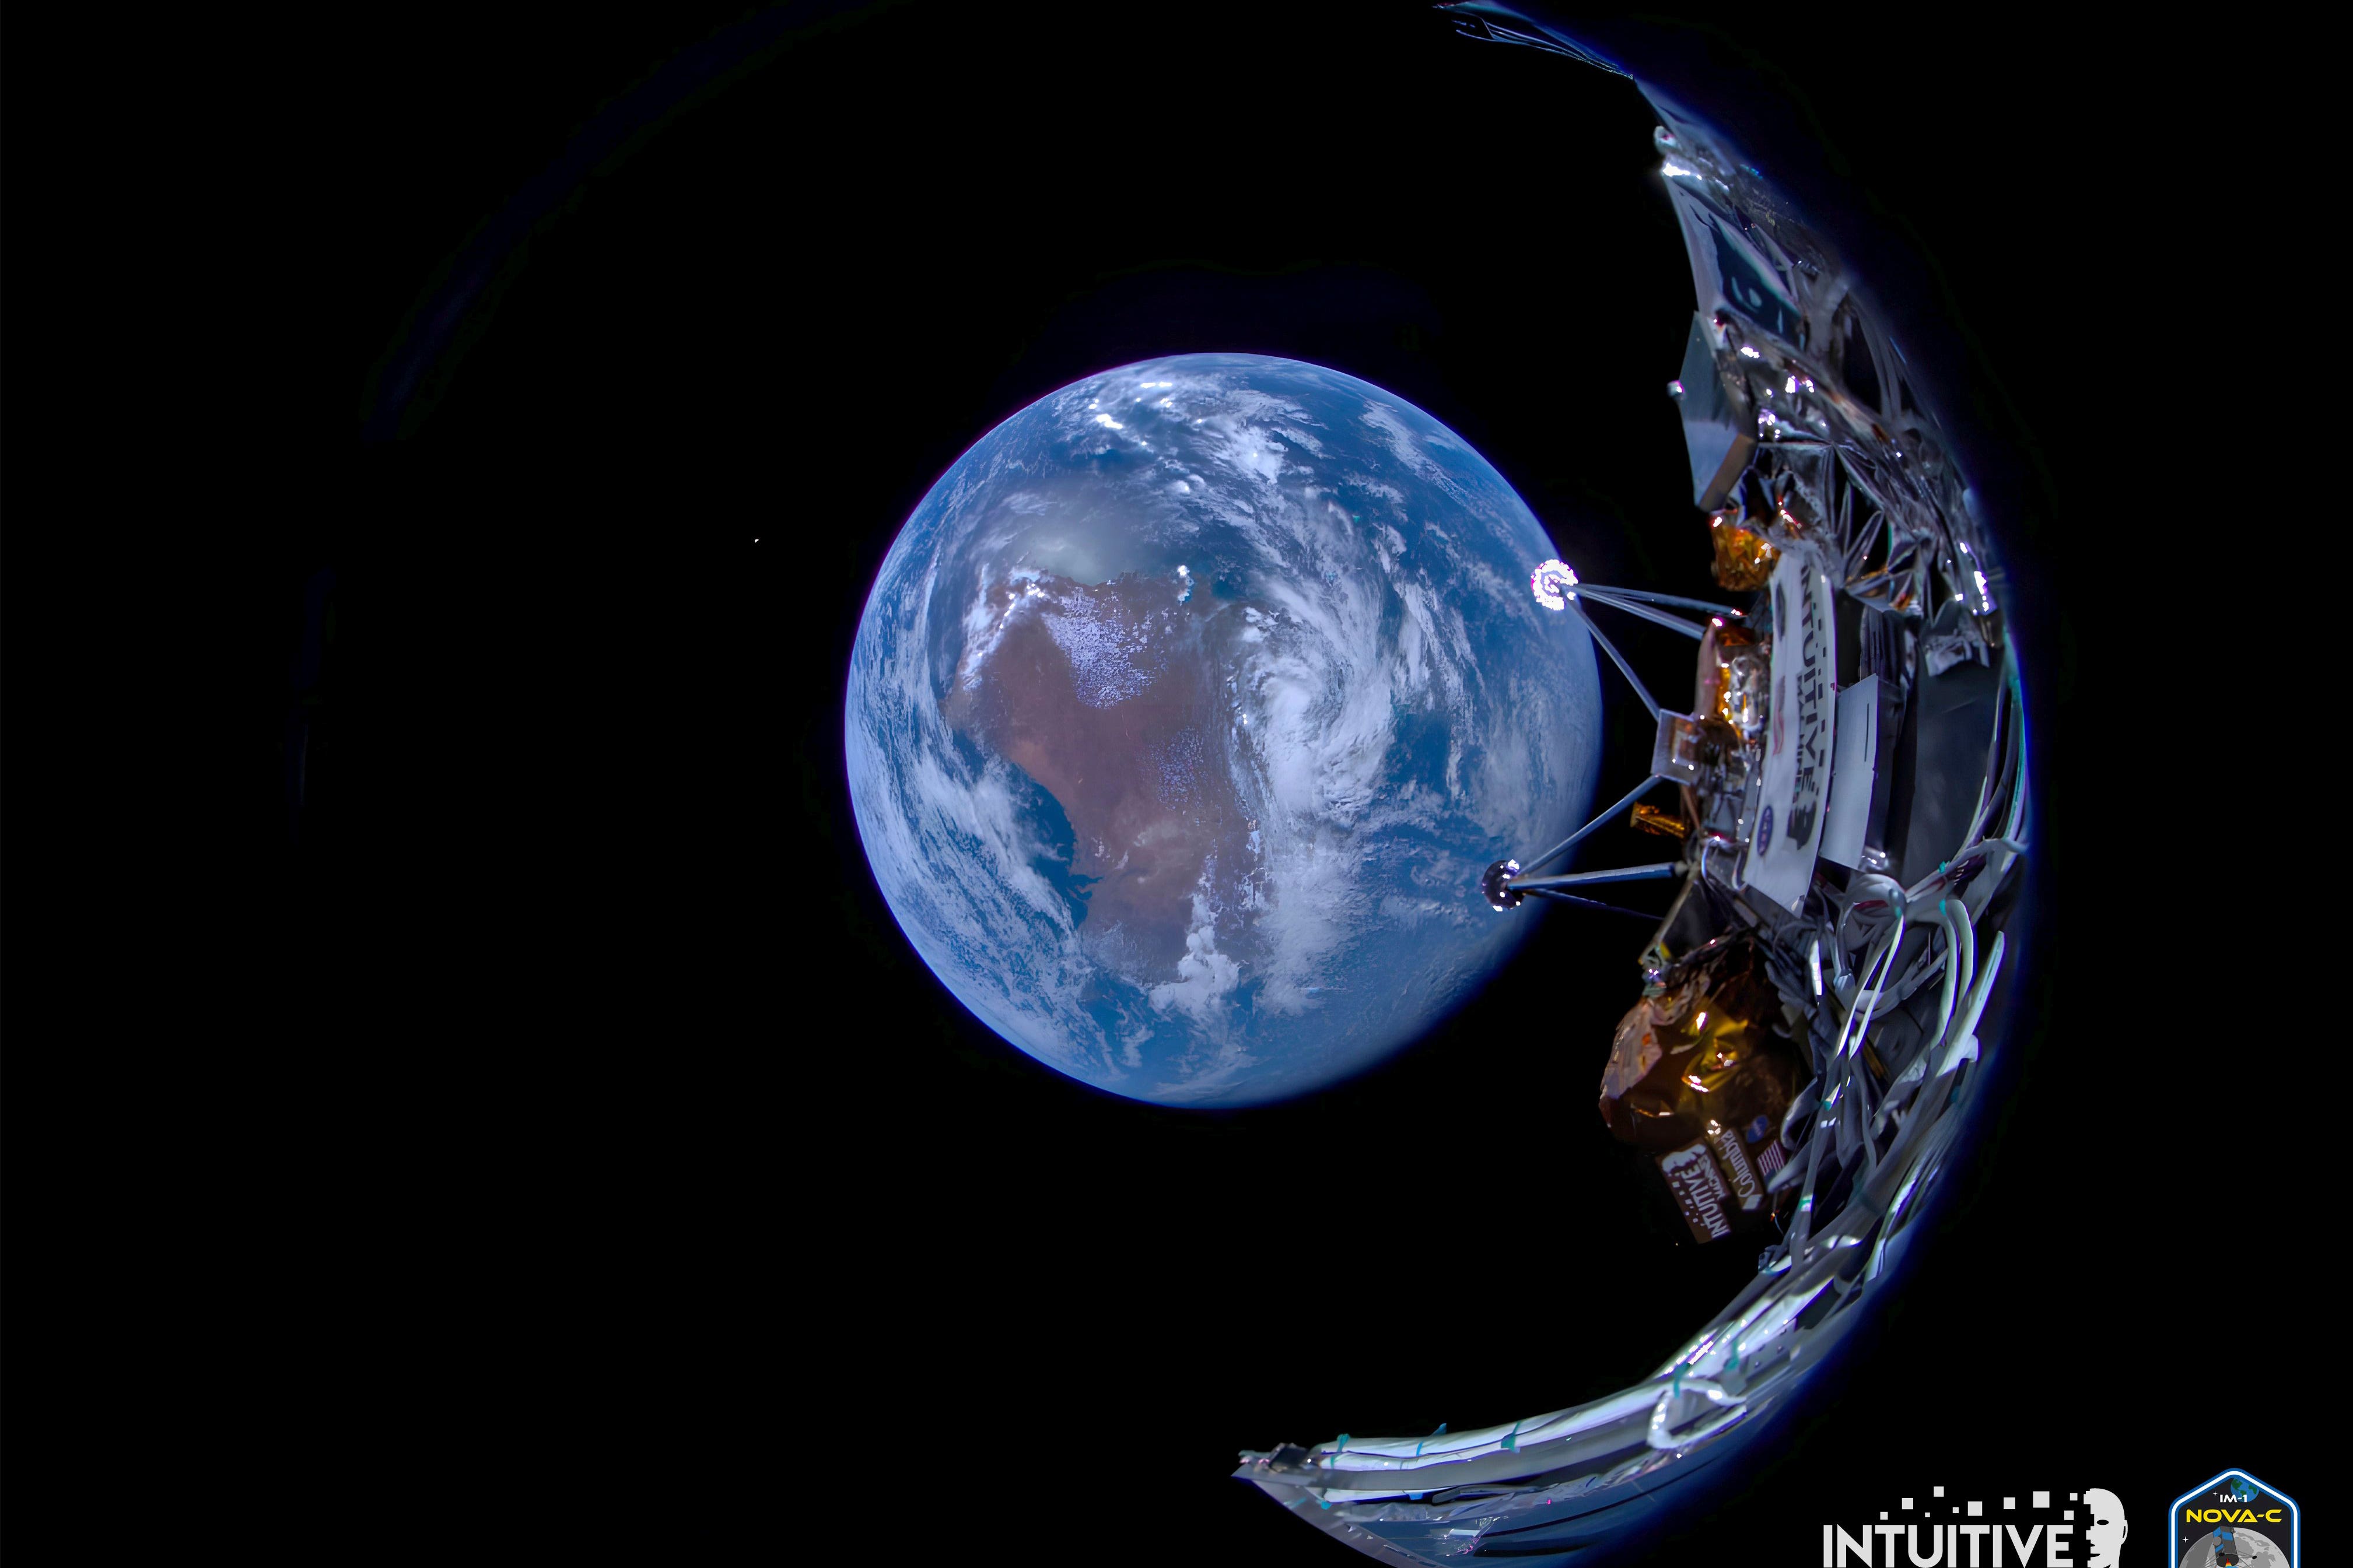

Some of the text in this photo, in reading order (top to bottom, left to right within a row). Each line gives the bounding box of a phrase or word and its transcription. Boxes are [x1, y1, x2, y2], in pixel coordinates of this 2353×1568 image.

[1801, 564, 1818, 792] INTUITIVE
[1680, 1163, 1731, 1239] INTUITIVE
[1718, 1129, 1755, 1198] Columbia
